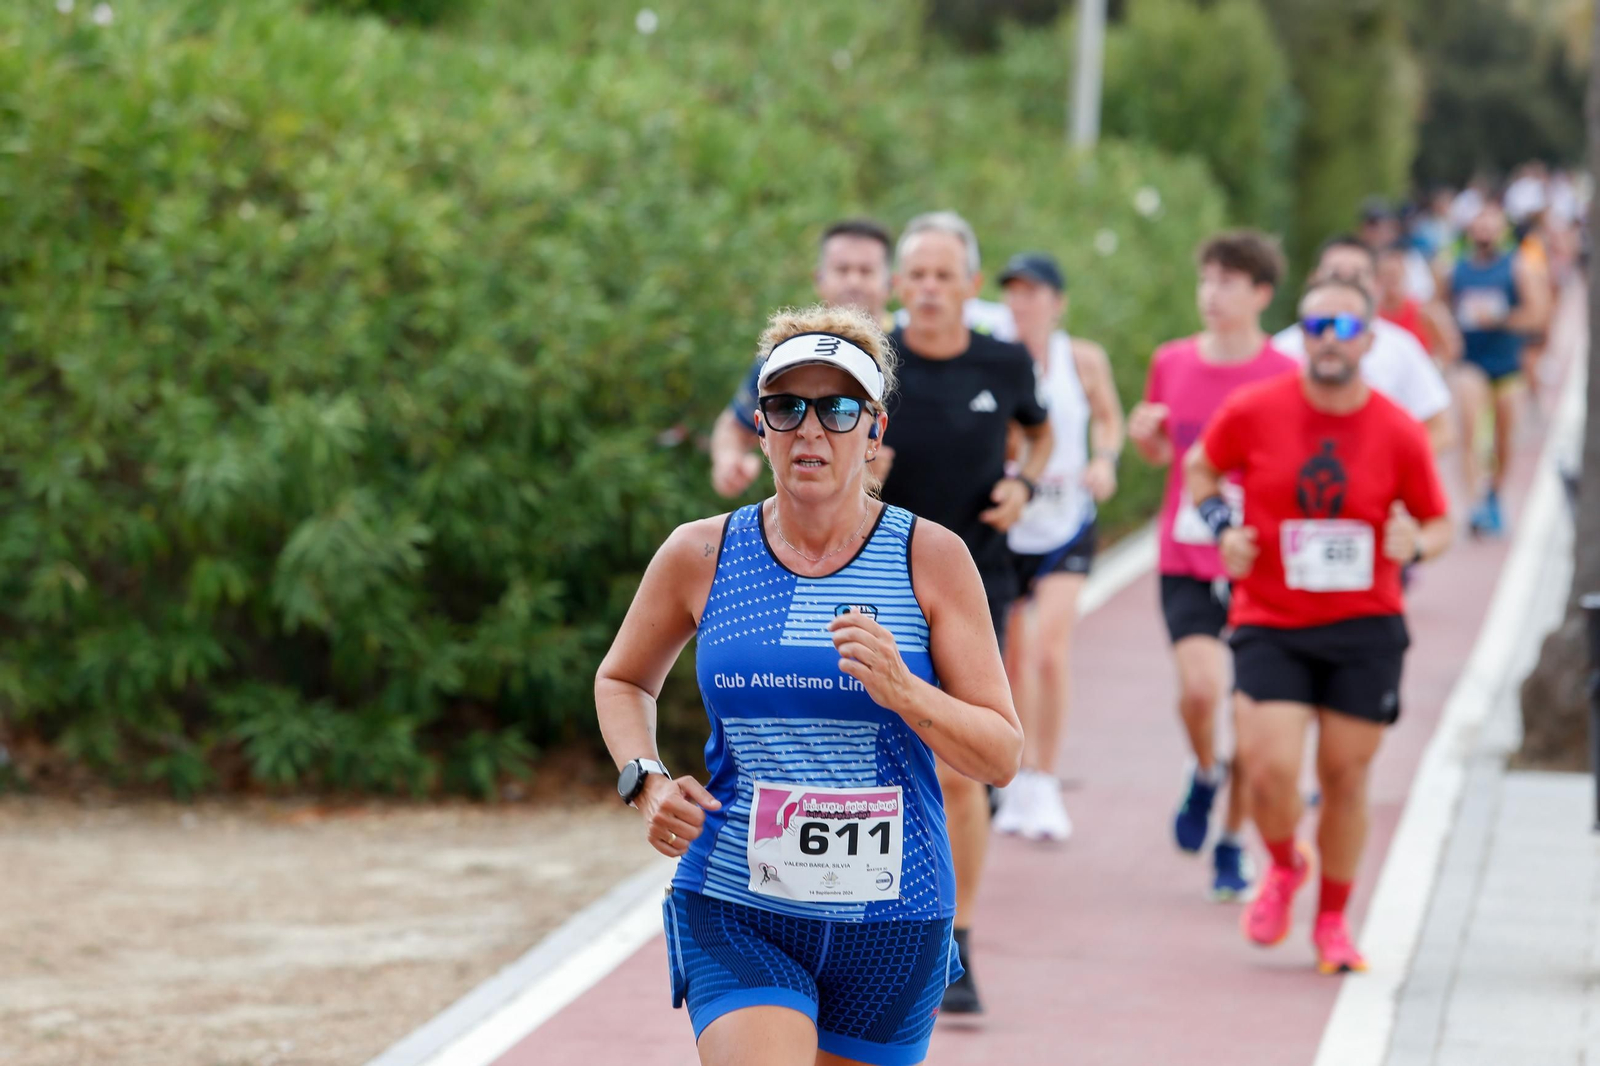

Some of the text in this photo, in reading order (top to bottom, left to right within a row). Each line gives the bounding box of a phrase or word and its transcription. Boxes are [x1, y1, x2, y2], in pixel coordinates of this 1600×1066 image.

[714, 672, 865, 692] Club Atletismo Lin
[799, 821, 891, 856] 611
